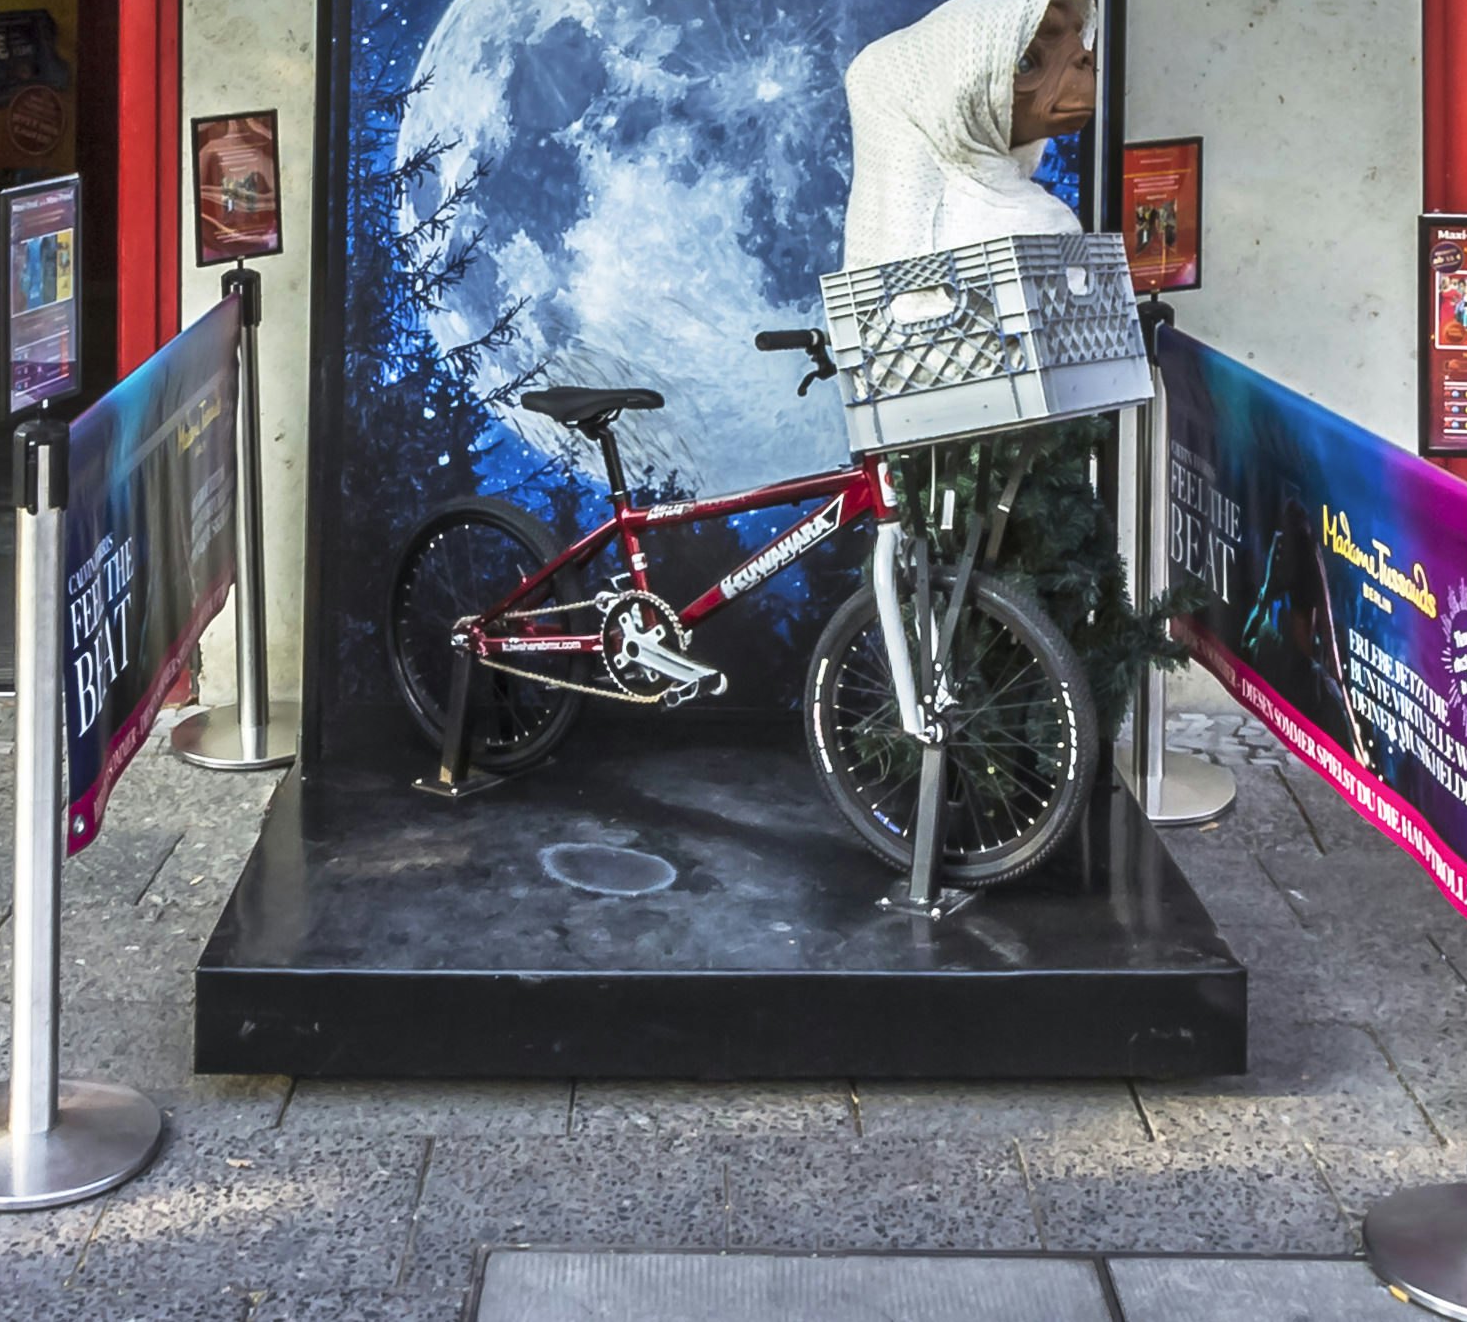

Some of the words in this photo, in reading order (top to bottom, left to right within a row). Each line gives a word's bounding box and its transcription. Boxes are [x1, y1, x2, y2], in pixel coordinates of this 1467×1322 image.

[721, 515, 835, 598] KUWAHARA
[1170, 501, 1236, 605] BEAT
[1171, 459, 1208, 516] FEEL
[1208, 485, 1242, 542] THE
[70, 573, 104, 651] FEEL
[103, 537, 133, 602] THE
[1323, 504, 1379, 580] Madame
[1371, 538, 1437, 619] Tussauds
[74, 592, 131, 738] BEAT
[1273, 706, 1315, 765] SOMMER
[1376, 795, 1402, 831] DIE
